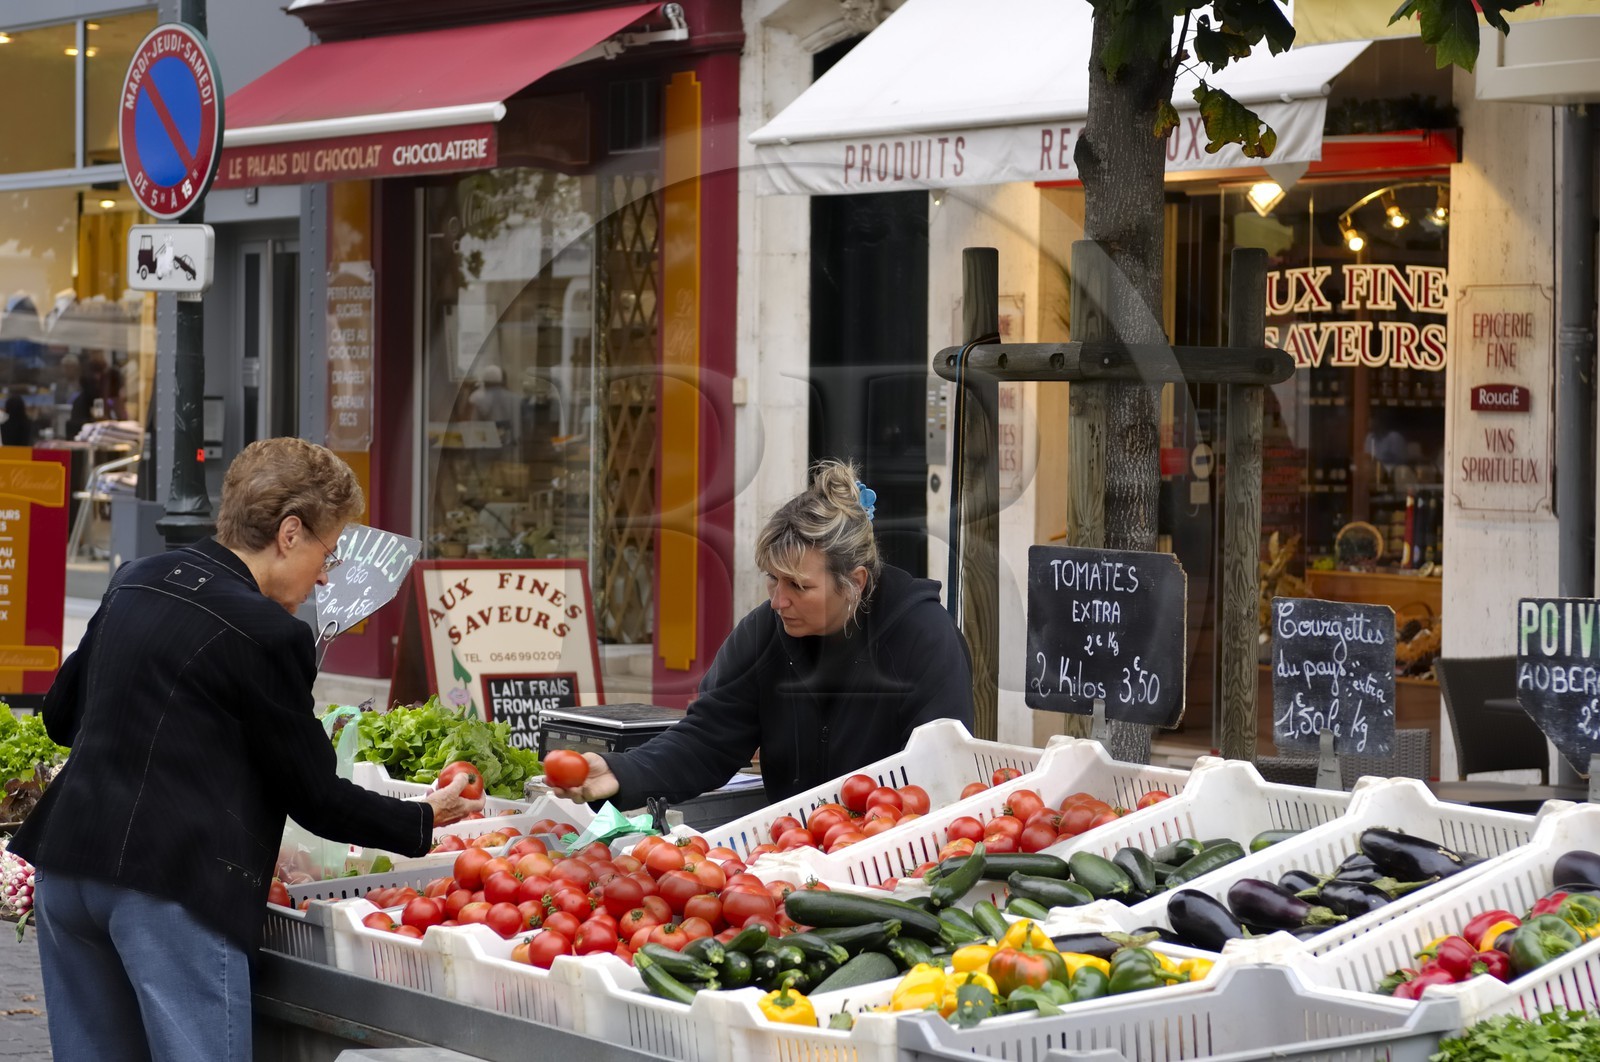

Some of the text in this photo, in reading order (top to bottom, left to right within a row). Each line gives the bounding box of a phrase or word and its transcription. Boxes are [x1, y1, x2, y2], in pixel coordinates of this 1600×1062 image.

[228, 157, 242, 180] LE
[247, 153, 288, 177] PALAIS
[292, 151, 309, 175] DU
[313, 144, 382, 173] CHOCOLAT
[392, 137, 489, 166] CHOCOLATERIE
[844, 136, 966, 185] PRODUITS
[134, 171, 149, 196] DE
[1265, 263, 1450, 317] UX FINE
[1472, 311, 1535, 339] EPICERIE
[1486, 342, 1518, 369] FINE
[1484, 427, 1515, 455] VINS
[1460, 455, 1539, 485] SPIRITUEUX
[336, 529, 414, 583] SALADES
[1049, 558, 1139, 594] TOMATES
[428, 571, 583, 628] AUX FINES
[1072, 599, 1121, 624] EXTRA
[448, 605, 571, 646] SAVEURS
[1278, 601, 1385, 664] Courgettes
[464, 652, 482, 663] TEL
[1030, 651, 1051, 698] 2
[1058, 655, 1107, 701] Kilos
[1277, 648, 1301, 678] du
[1302, 659, 1347, 697] pays
[492, 697, 561, 714] FROMAGE
